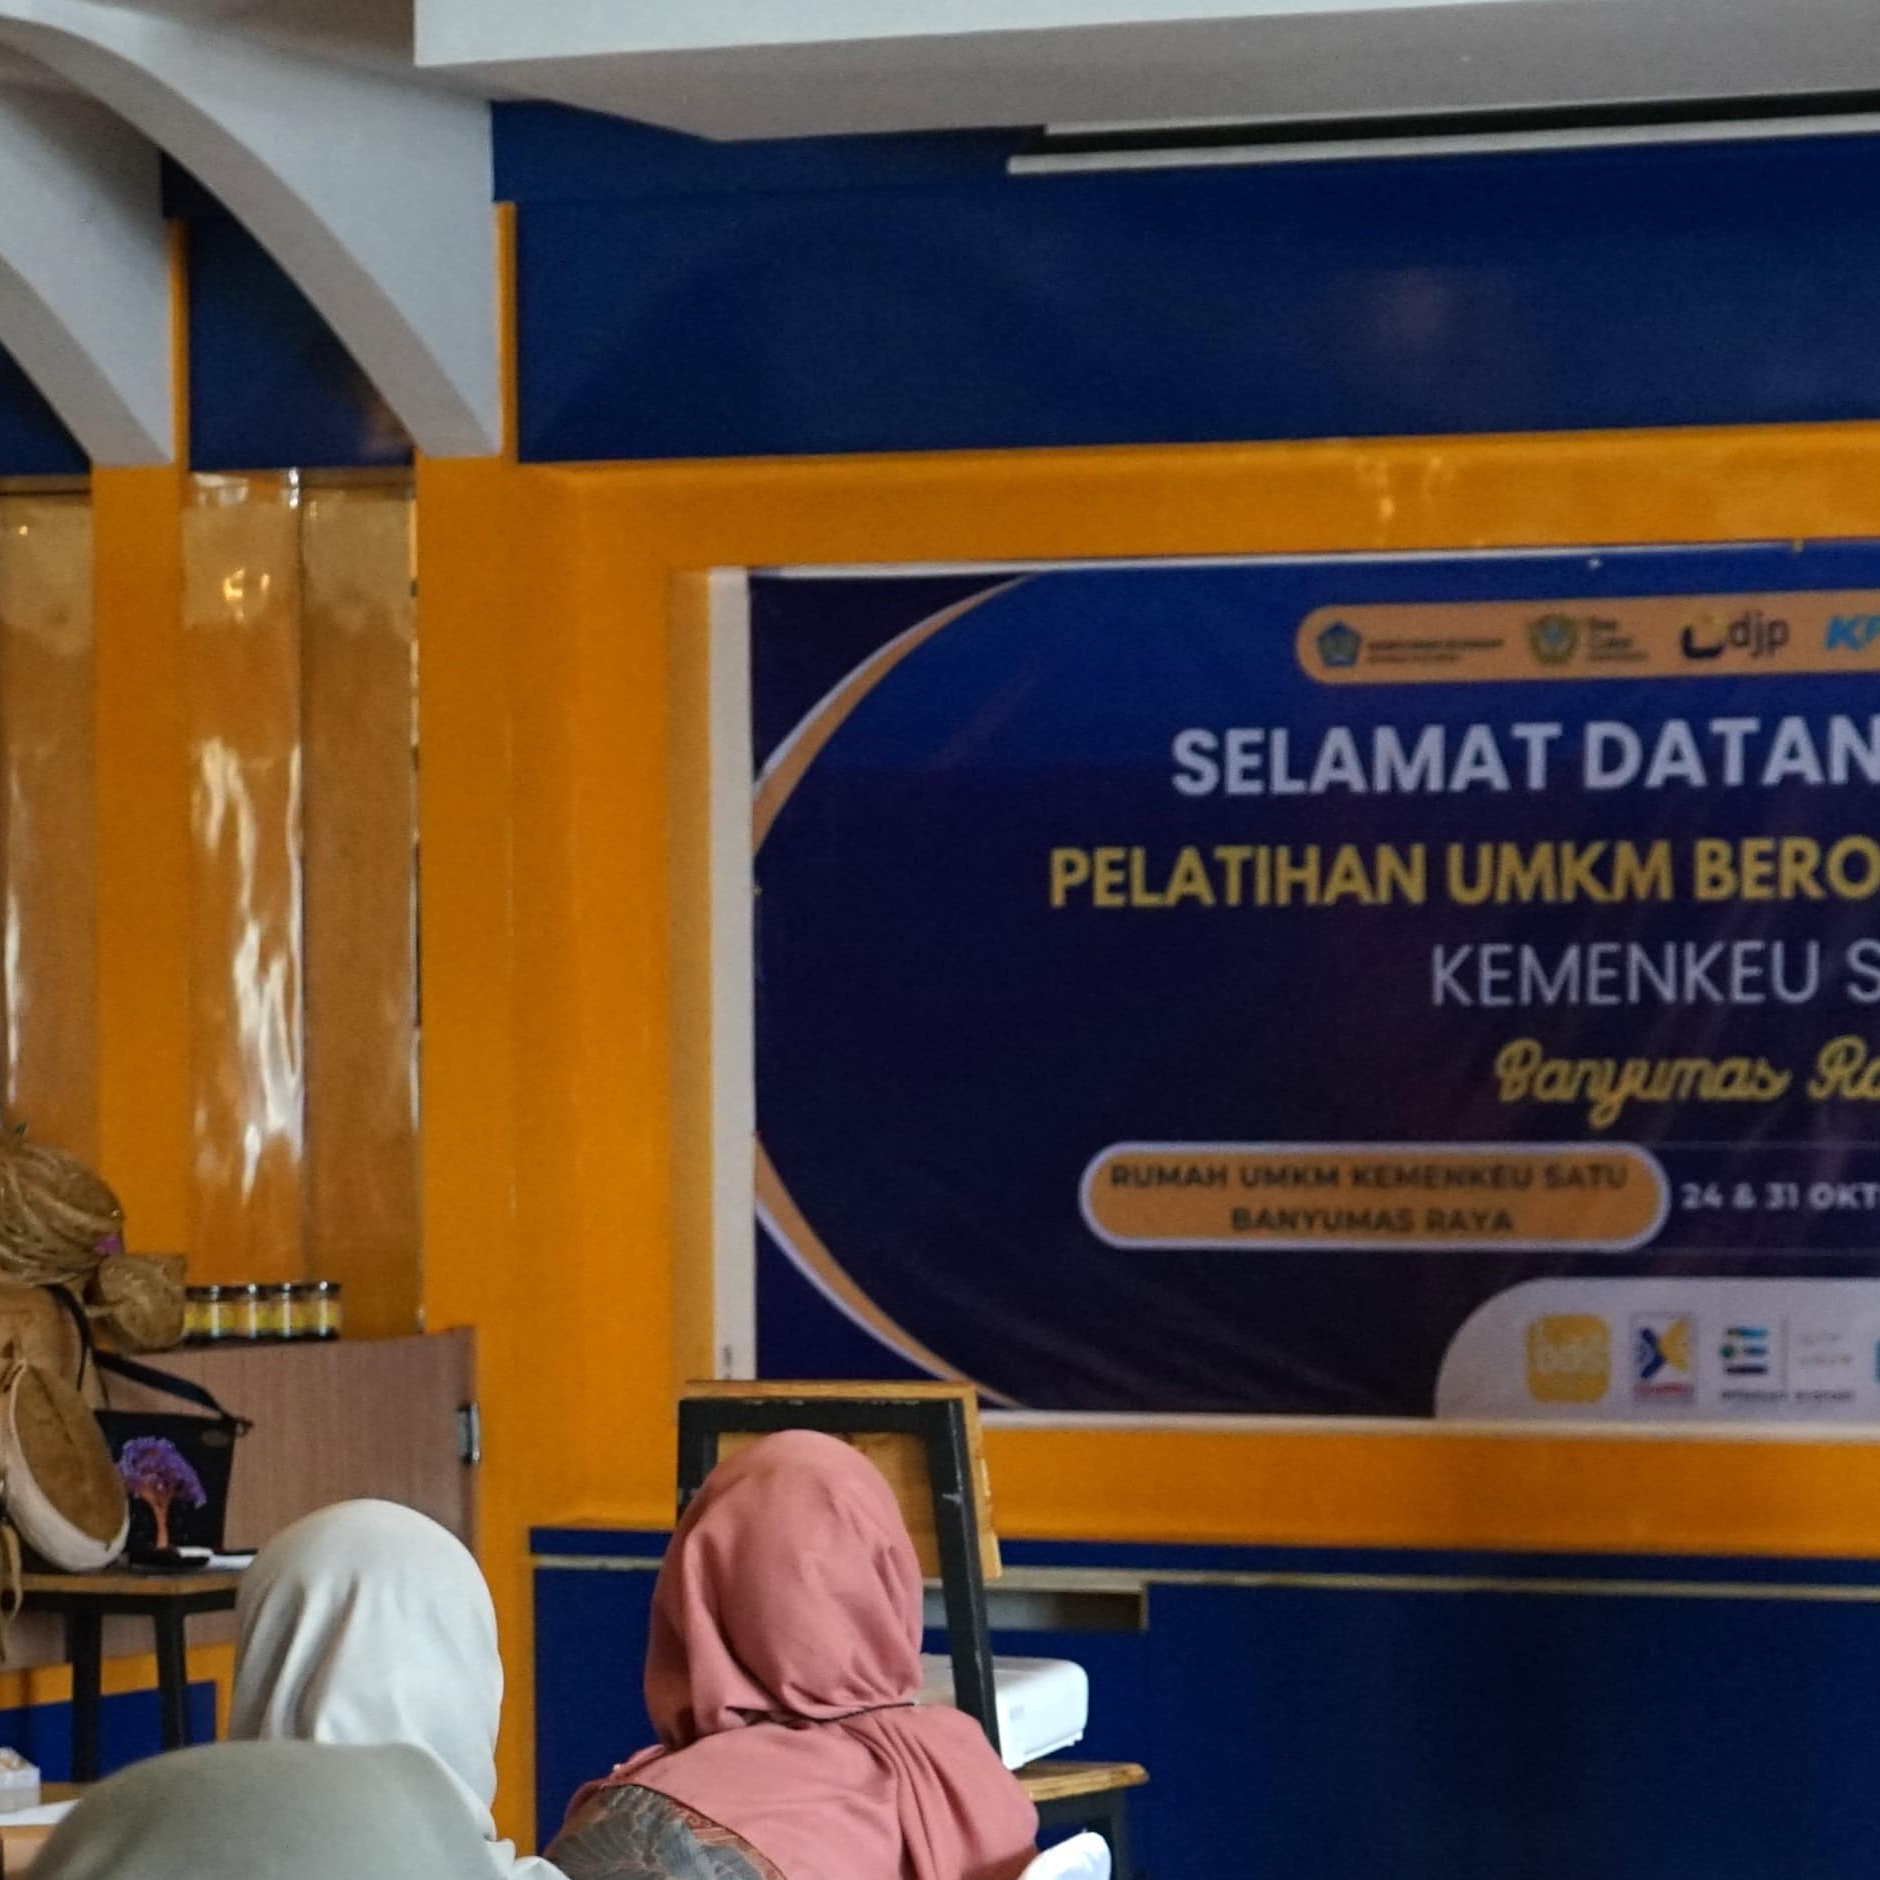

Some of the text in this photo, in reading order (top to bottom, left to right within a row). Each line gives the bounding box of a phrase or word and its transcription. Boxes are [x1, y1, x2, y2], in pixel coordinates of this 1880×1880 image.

[1733, 609, 1788, 656] djp
[1172, 722, 1562, 795] SELAMAT
[1050, 843, 1426, 908] PELATIHAN
[1447, 840, 1672, 904] UMKM
[1432, 940, 1821, 1006] KEMENKEU
[1494, 1038, 1792, 1129] Banyumas
[1111, 1162, 1629, 1190] RUMAH UMKM KEMENKEU SATU
[1681, 1182, 1721, 1210] 24
[1734, 1182, 1756, 1210] &
[1764, 1182, 1799, 1210] 31
[1231, 1207, 1515, 1232] BANYUMAS RAYA
